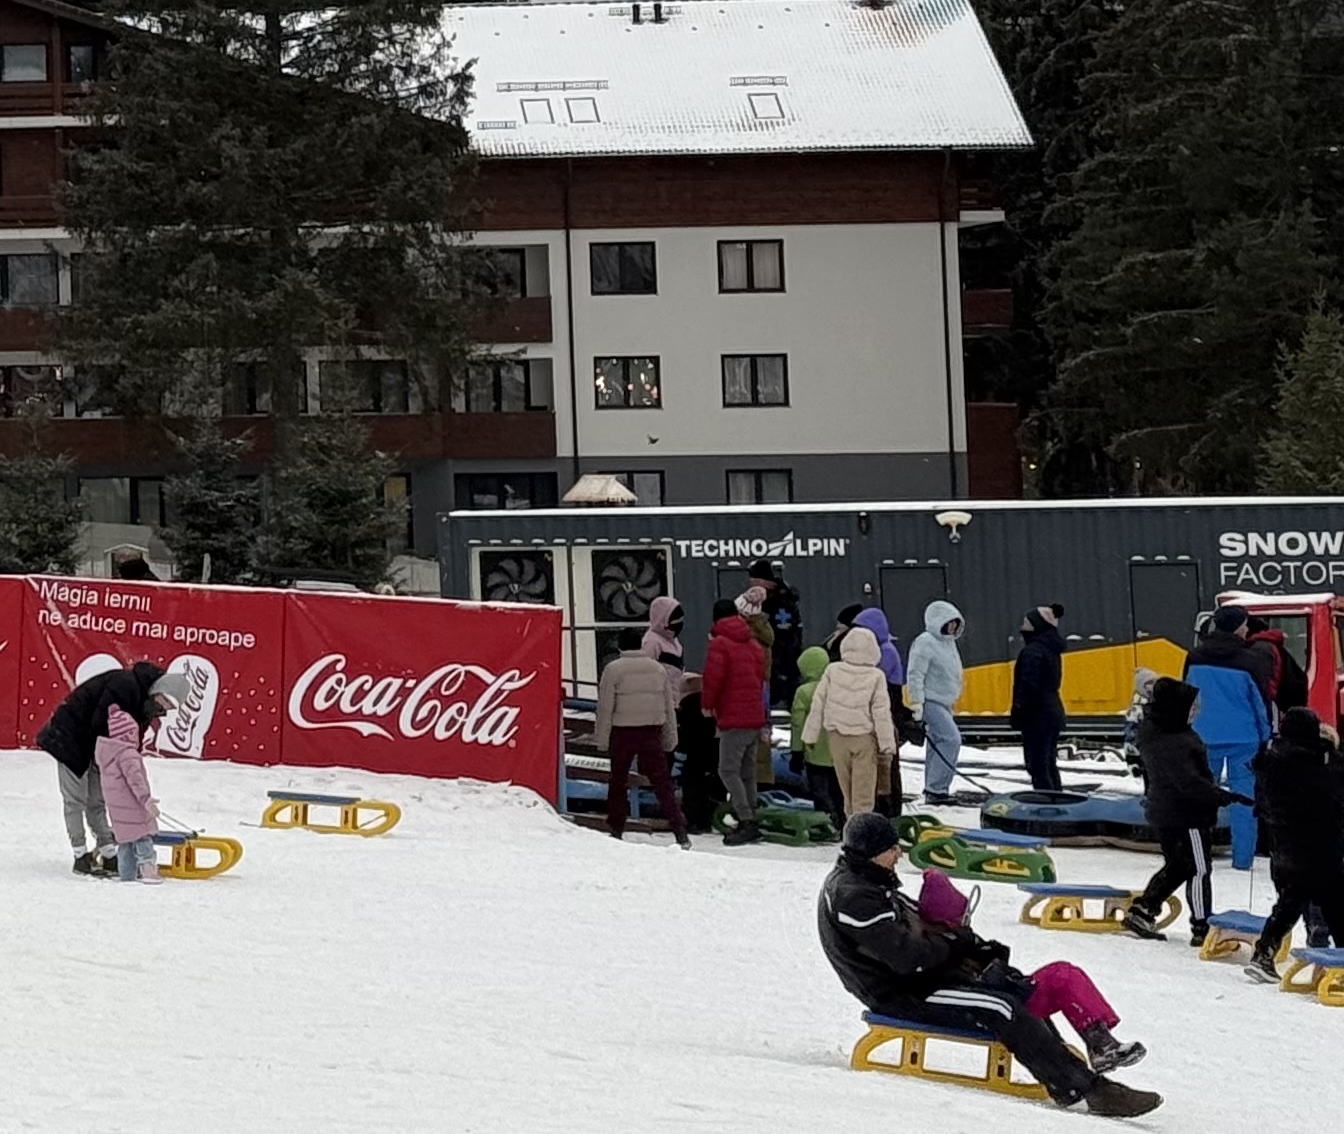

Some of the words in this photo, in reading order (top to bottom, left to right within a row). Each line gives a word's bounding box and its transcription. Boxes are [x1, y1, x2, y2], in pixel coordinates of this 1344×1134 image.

[676, 531, 845, 558] TECHNOALPIN
[1219, 531, 1344, 557] SNOW
[39, 581, 98, 607] Magia
[104, 587, 152, 613] iernii
[38, 609, 62, 626] ne
[67, 612, 127, 634] aduce
[131, 620, 168, 640] mai
[173, 625, 256, 651] aproape
[288, 654, 538, 747] Coca-Cola
